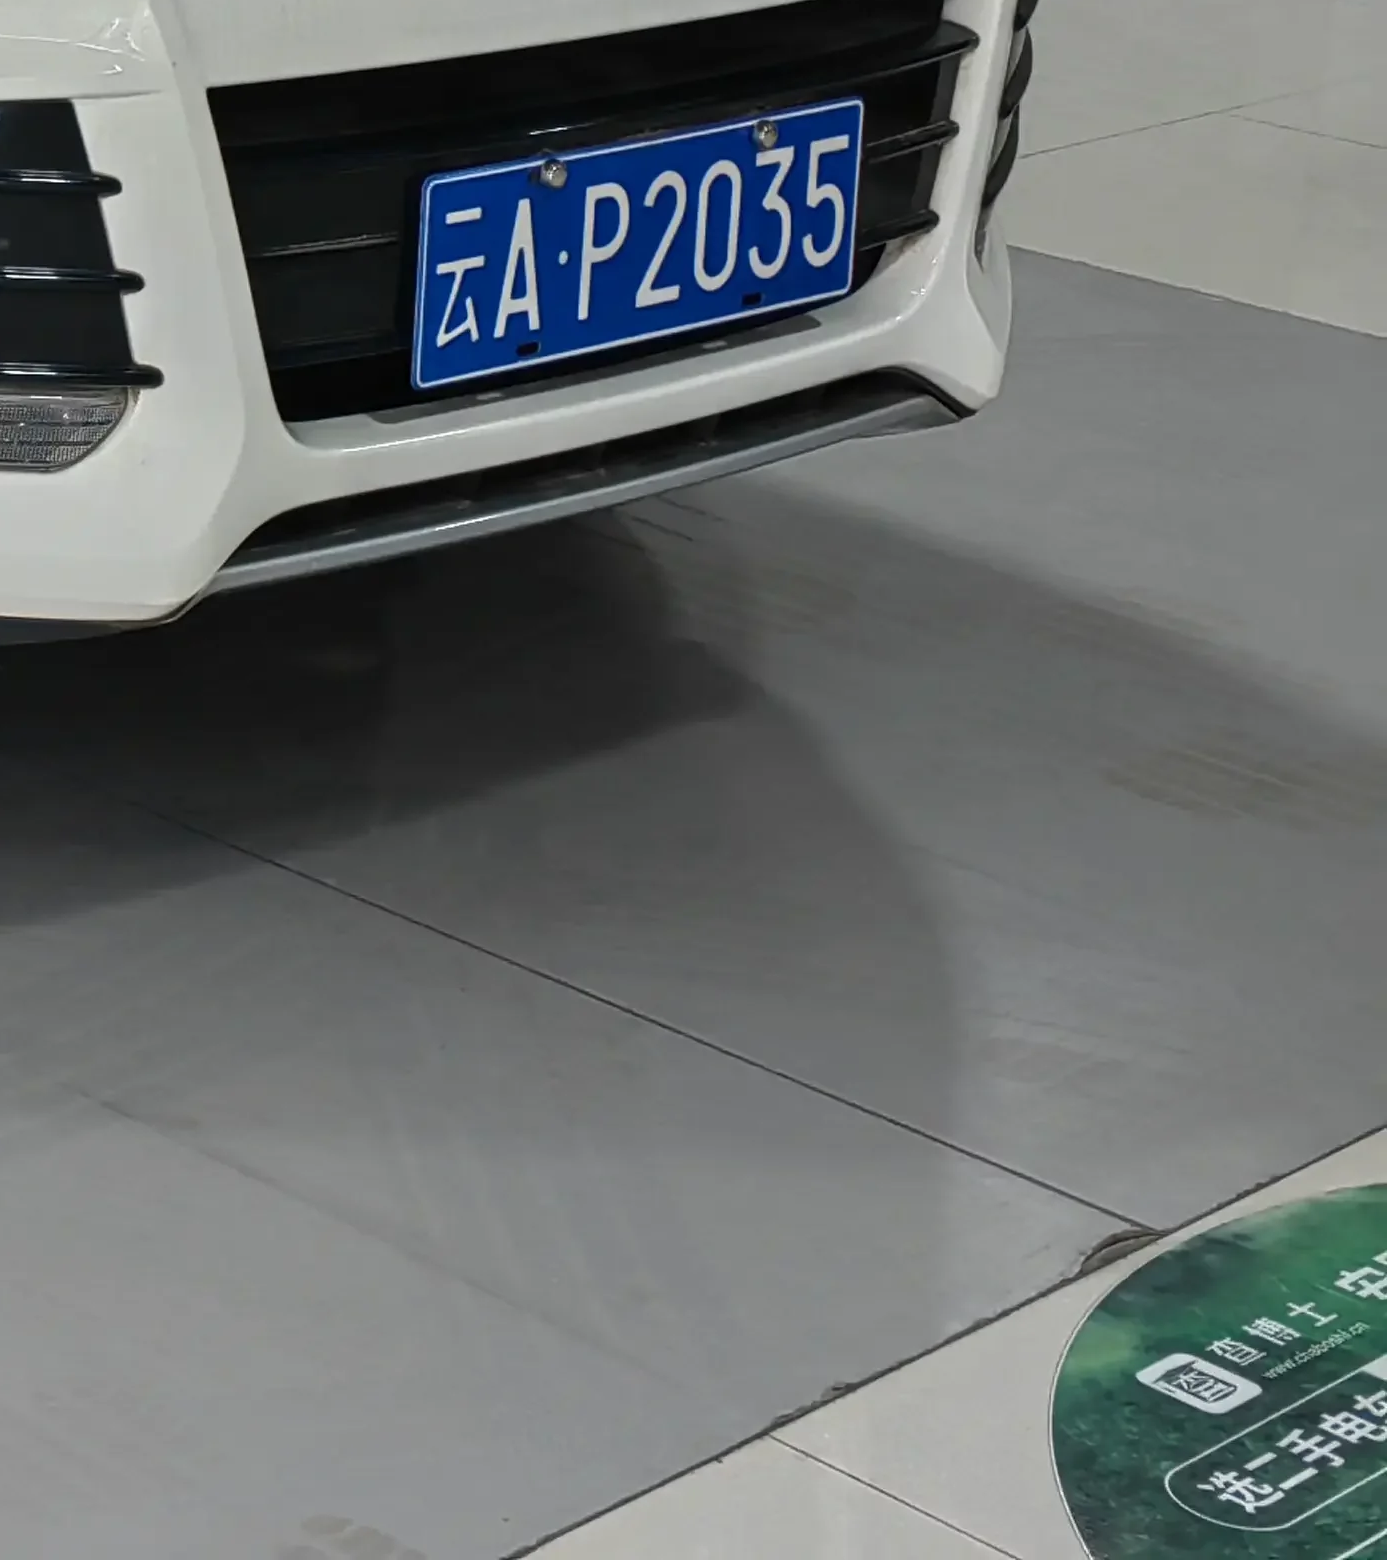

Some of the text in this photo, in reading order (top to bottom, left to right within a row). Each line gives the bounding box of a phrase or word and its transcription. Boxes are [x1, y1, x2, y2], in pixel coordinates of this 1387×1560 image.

[435, 134, 851, 347] 云A·P2035
[1206, 1300, 1338, 1365] 查博士
